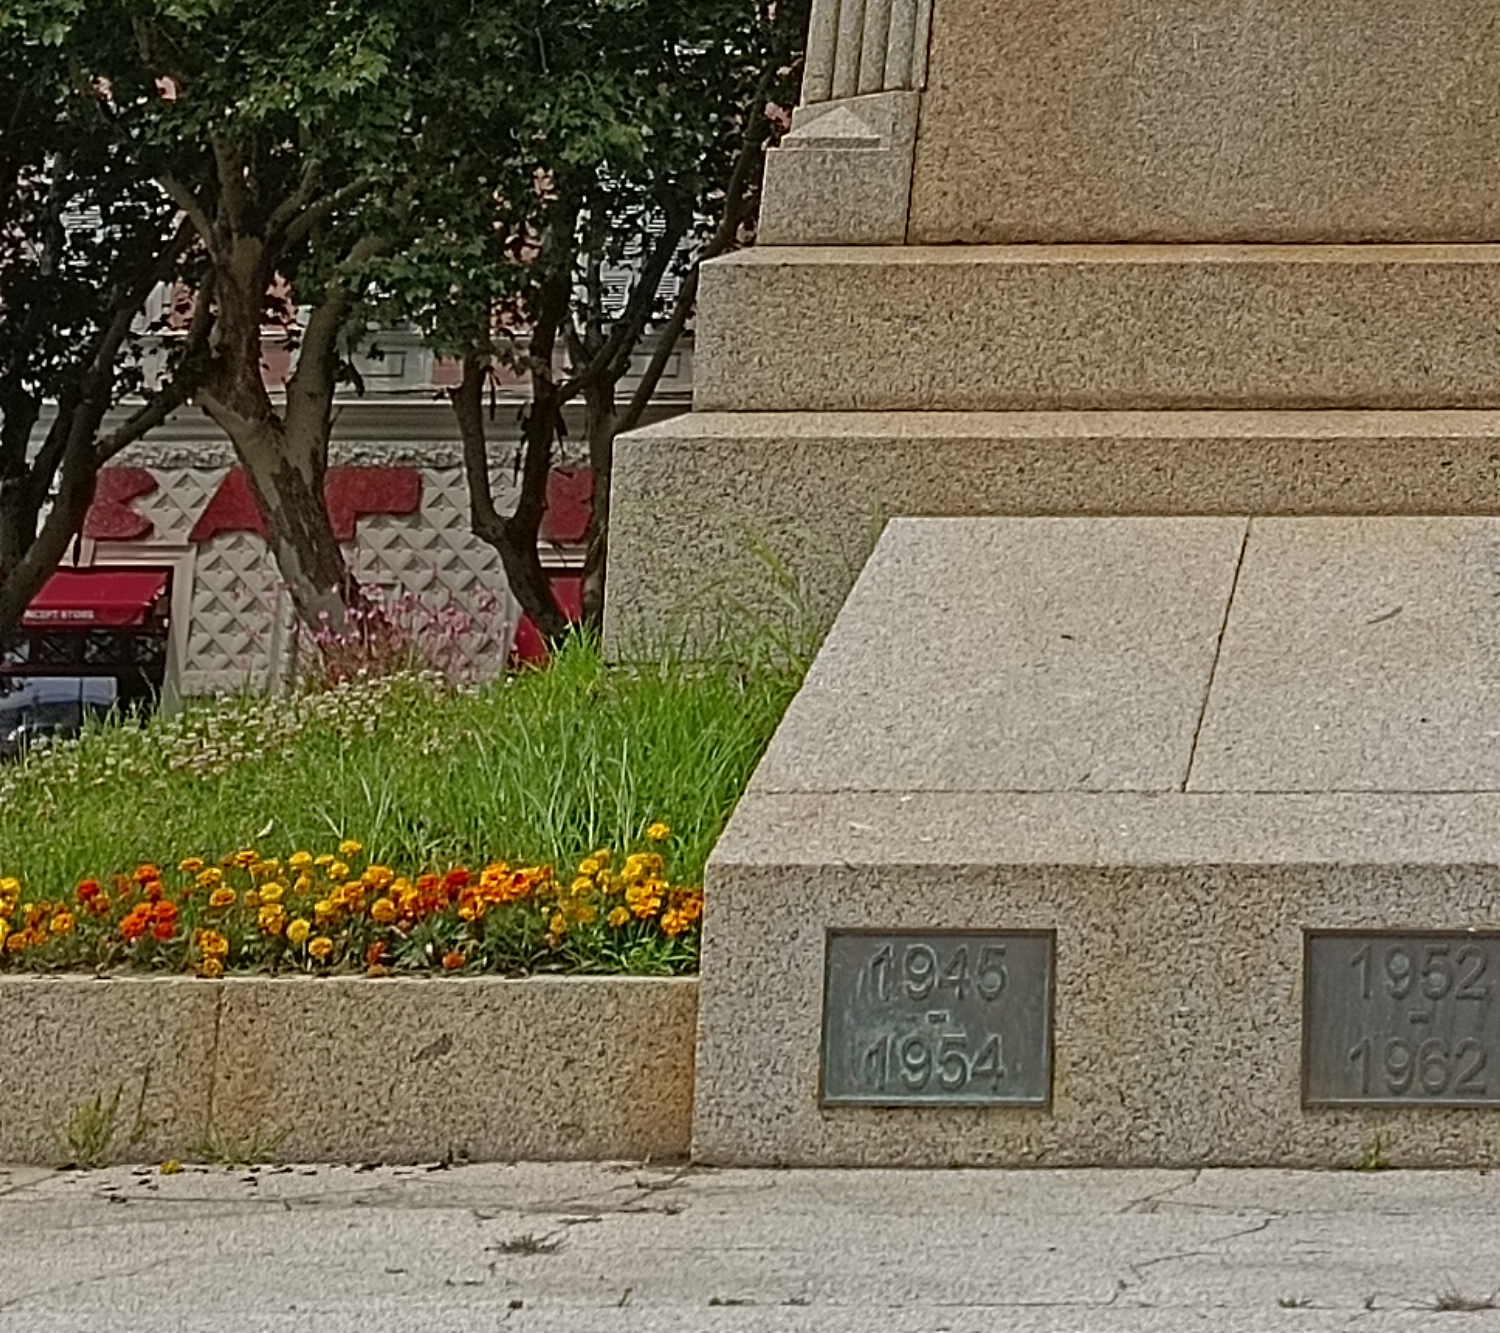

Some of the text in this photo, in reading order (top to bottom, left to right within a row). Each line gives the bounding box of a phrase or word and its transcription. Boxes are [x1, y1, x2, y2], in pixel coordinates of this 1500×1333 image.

[868, 943, 1008, 1002] 1945
[1350, 944, 1488, 1001] 1952
[863, 1033, 1006, 1092] 1954
[1350, 1036, 1488, 1095] 1962
